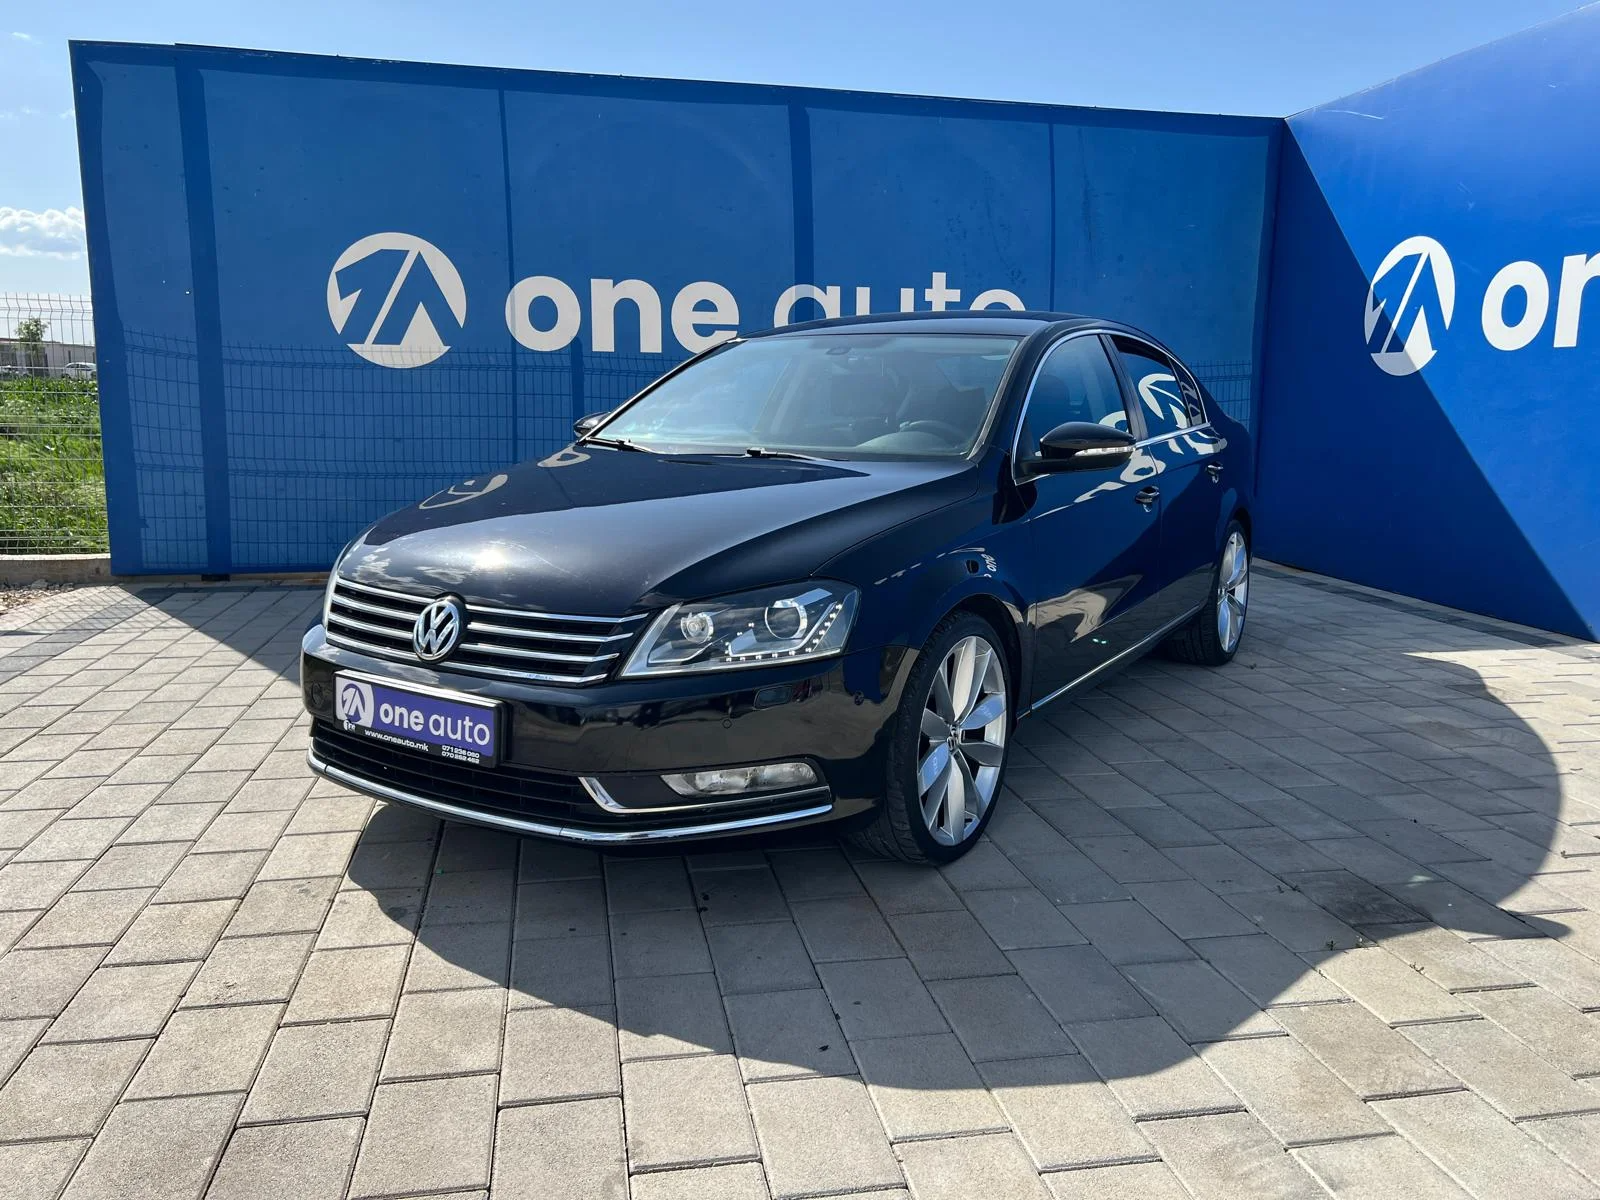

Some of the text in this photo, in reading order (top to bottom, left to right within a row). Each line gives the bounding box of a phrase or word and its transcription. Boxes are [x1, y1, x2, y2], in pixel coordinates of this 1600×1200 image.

[505, 275, 739, 354] one
[364, 729, 429, 752] www.oneauto.mk
[379, 703, 424, 732] one
[428, 714, 490, 746] auto
